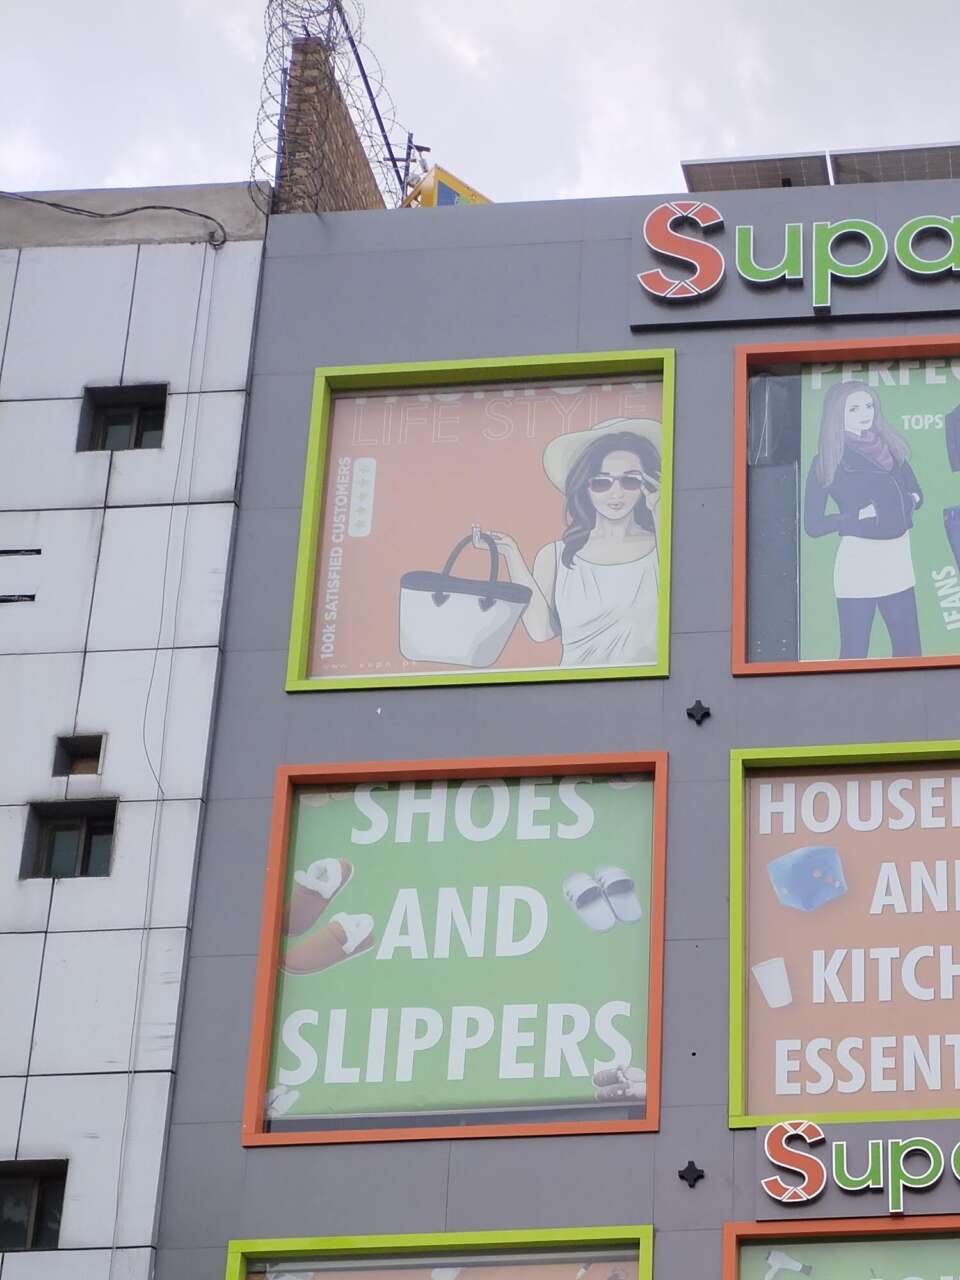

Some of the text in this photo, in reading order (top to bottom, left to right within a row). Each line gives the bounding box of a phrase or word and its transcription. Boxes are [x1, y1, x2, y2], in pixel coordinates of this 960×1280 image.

[352, 400, 463, 447] LIFE
[481, 390, 651, 442] STYLE
[901, 413, 944, 431] TOPS
[331, 456, 352, 543] CUSTOMERS
[324, 546, 344, 621] SATISFIED
[350, 775, 596, 846] SHOES
[375, 885, 549, 960] AND
[277, 1000, 633, 1087] SLIPPERS
